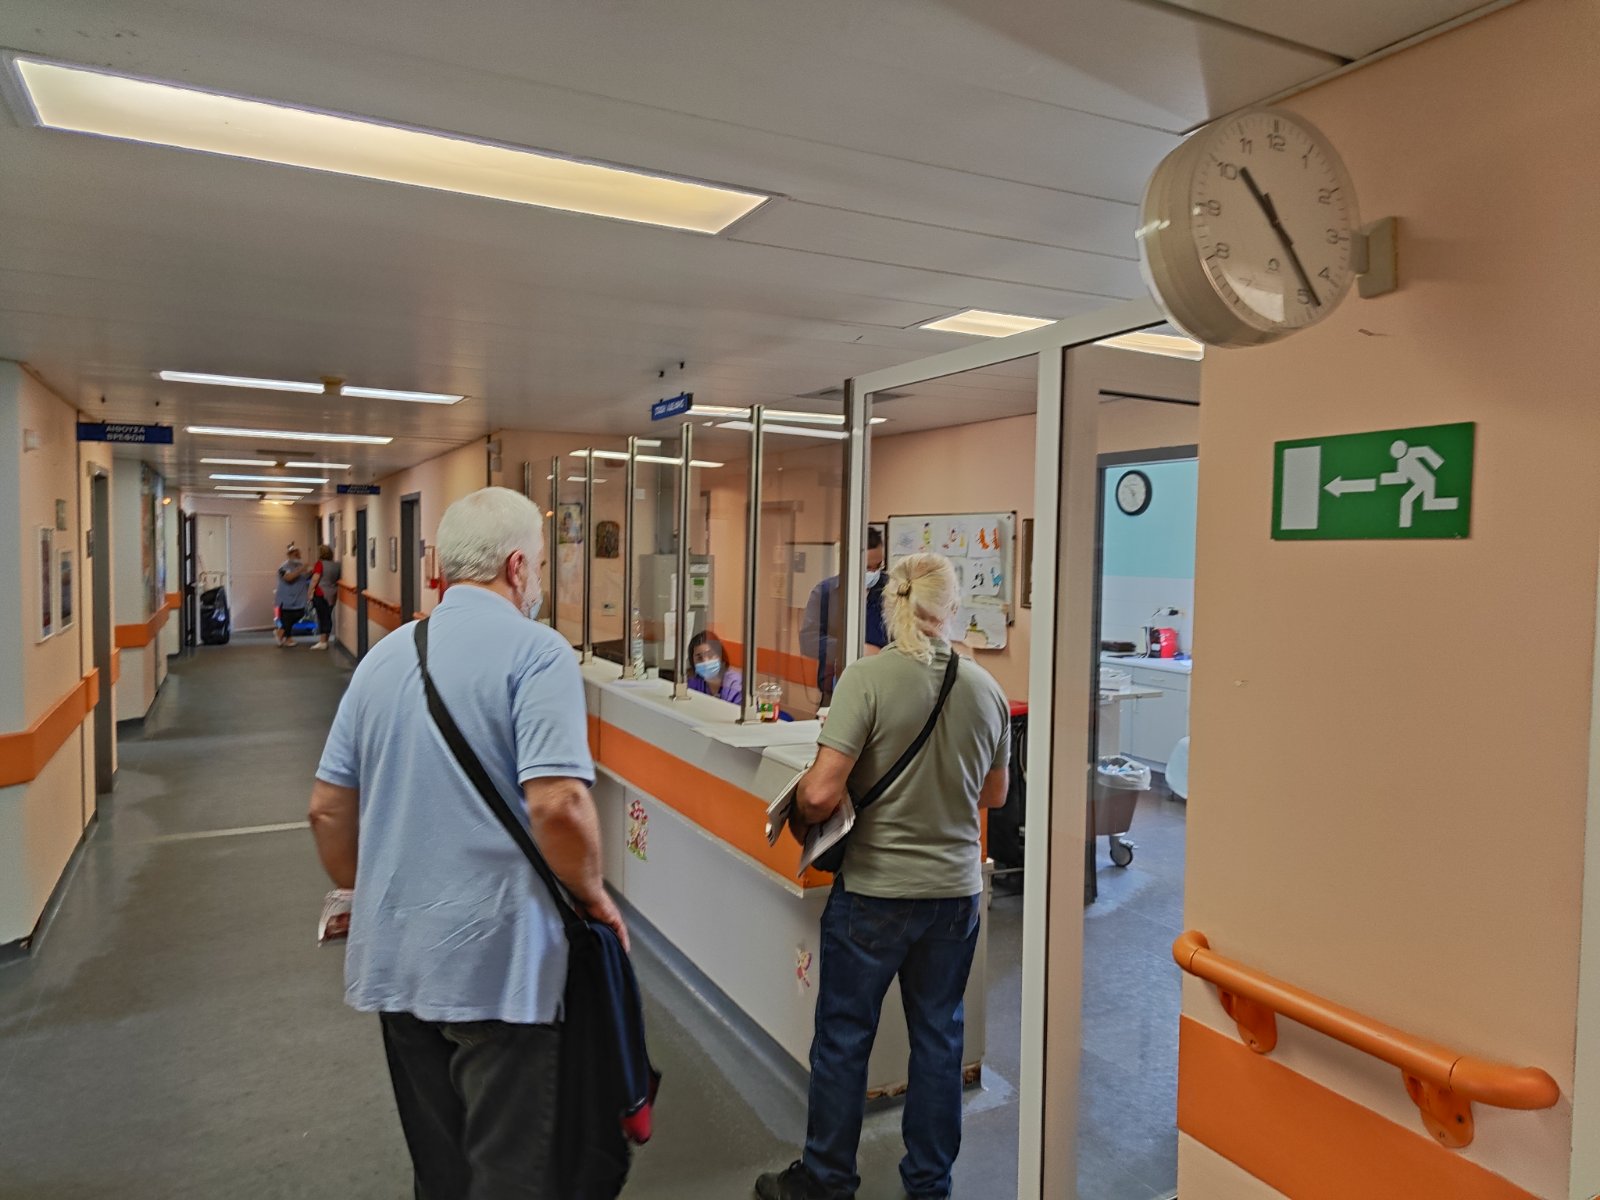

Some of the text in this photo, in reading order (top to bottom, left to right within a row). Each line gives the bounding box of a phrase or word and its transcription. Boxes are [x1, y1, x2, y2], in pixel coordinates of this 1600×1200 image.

[1239, 138, 1253, 155] 11
[1267, 133, 1286, 152] 12
[1302, 155, 1309, 169] 1
[1217, 161, 1238, 181] 10
[1318, 188, 1332, 205] 2
[1207, 199, 1222, 217] 9
[1326, 228, 1339, 245] 3
[1216, 242, 1230, 260] 8
[1318, 266, 1332, 281] 4
